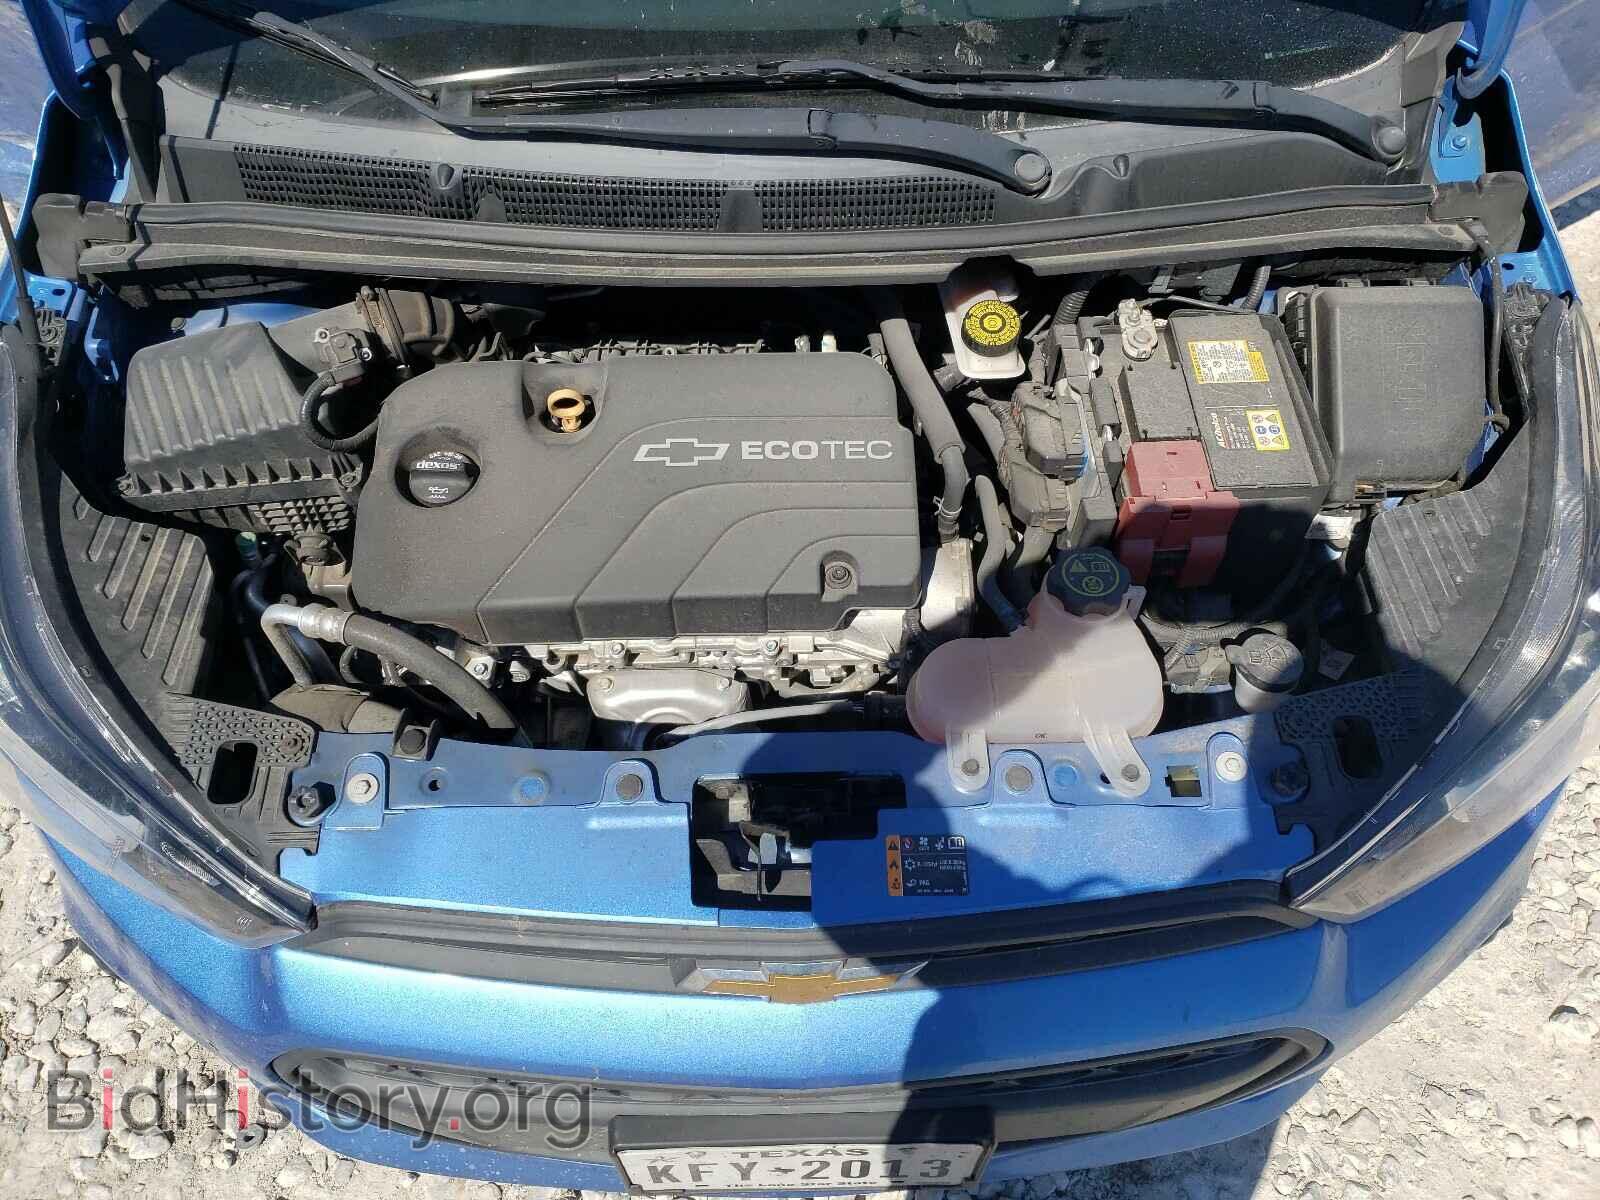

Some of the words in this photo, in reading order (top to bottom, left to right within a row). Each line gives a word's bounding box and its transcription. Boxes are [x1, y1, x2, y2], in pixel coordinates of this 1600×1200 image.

[741, 440, 894, 460] ECOTEC
[416, 459, 459, 470] dexos
[738, 1147, 870, 1160] TEXAS
[646, 1160, 758, 1185] KFY
[800, 1158, 953, 1182] 2013
